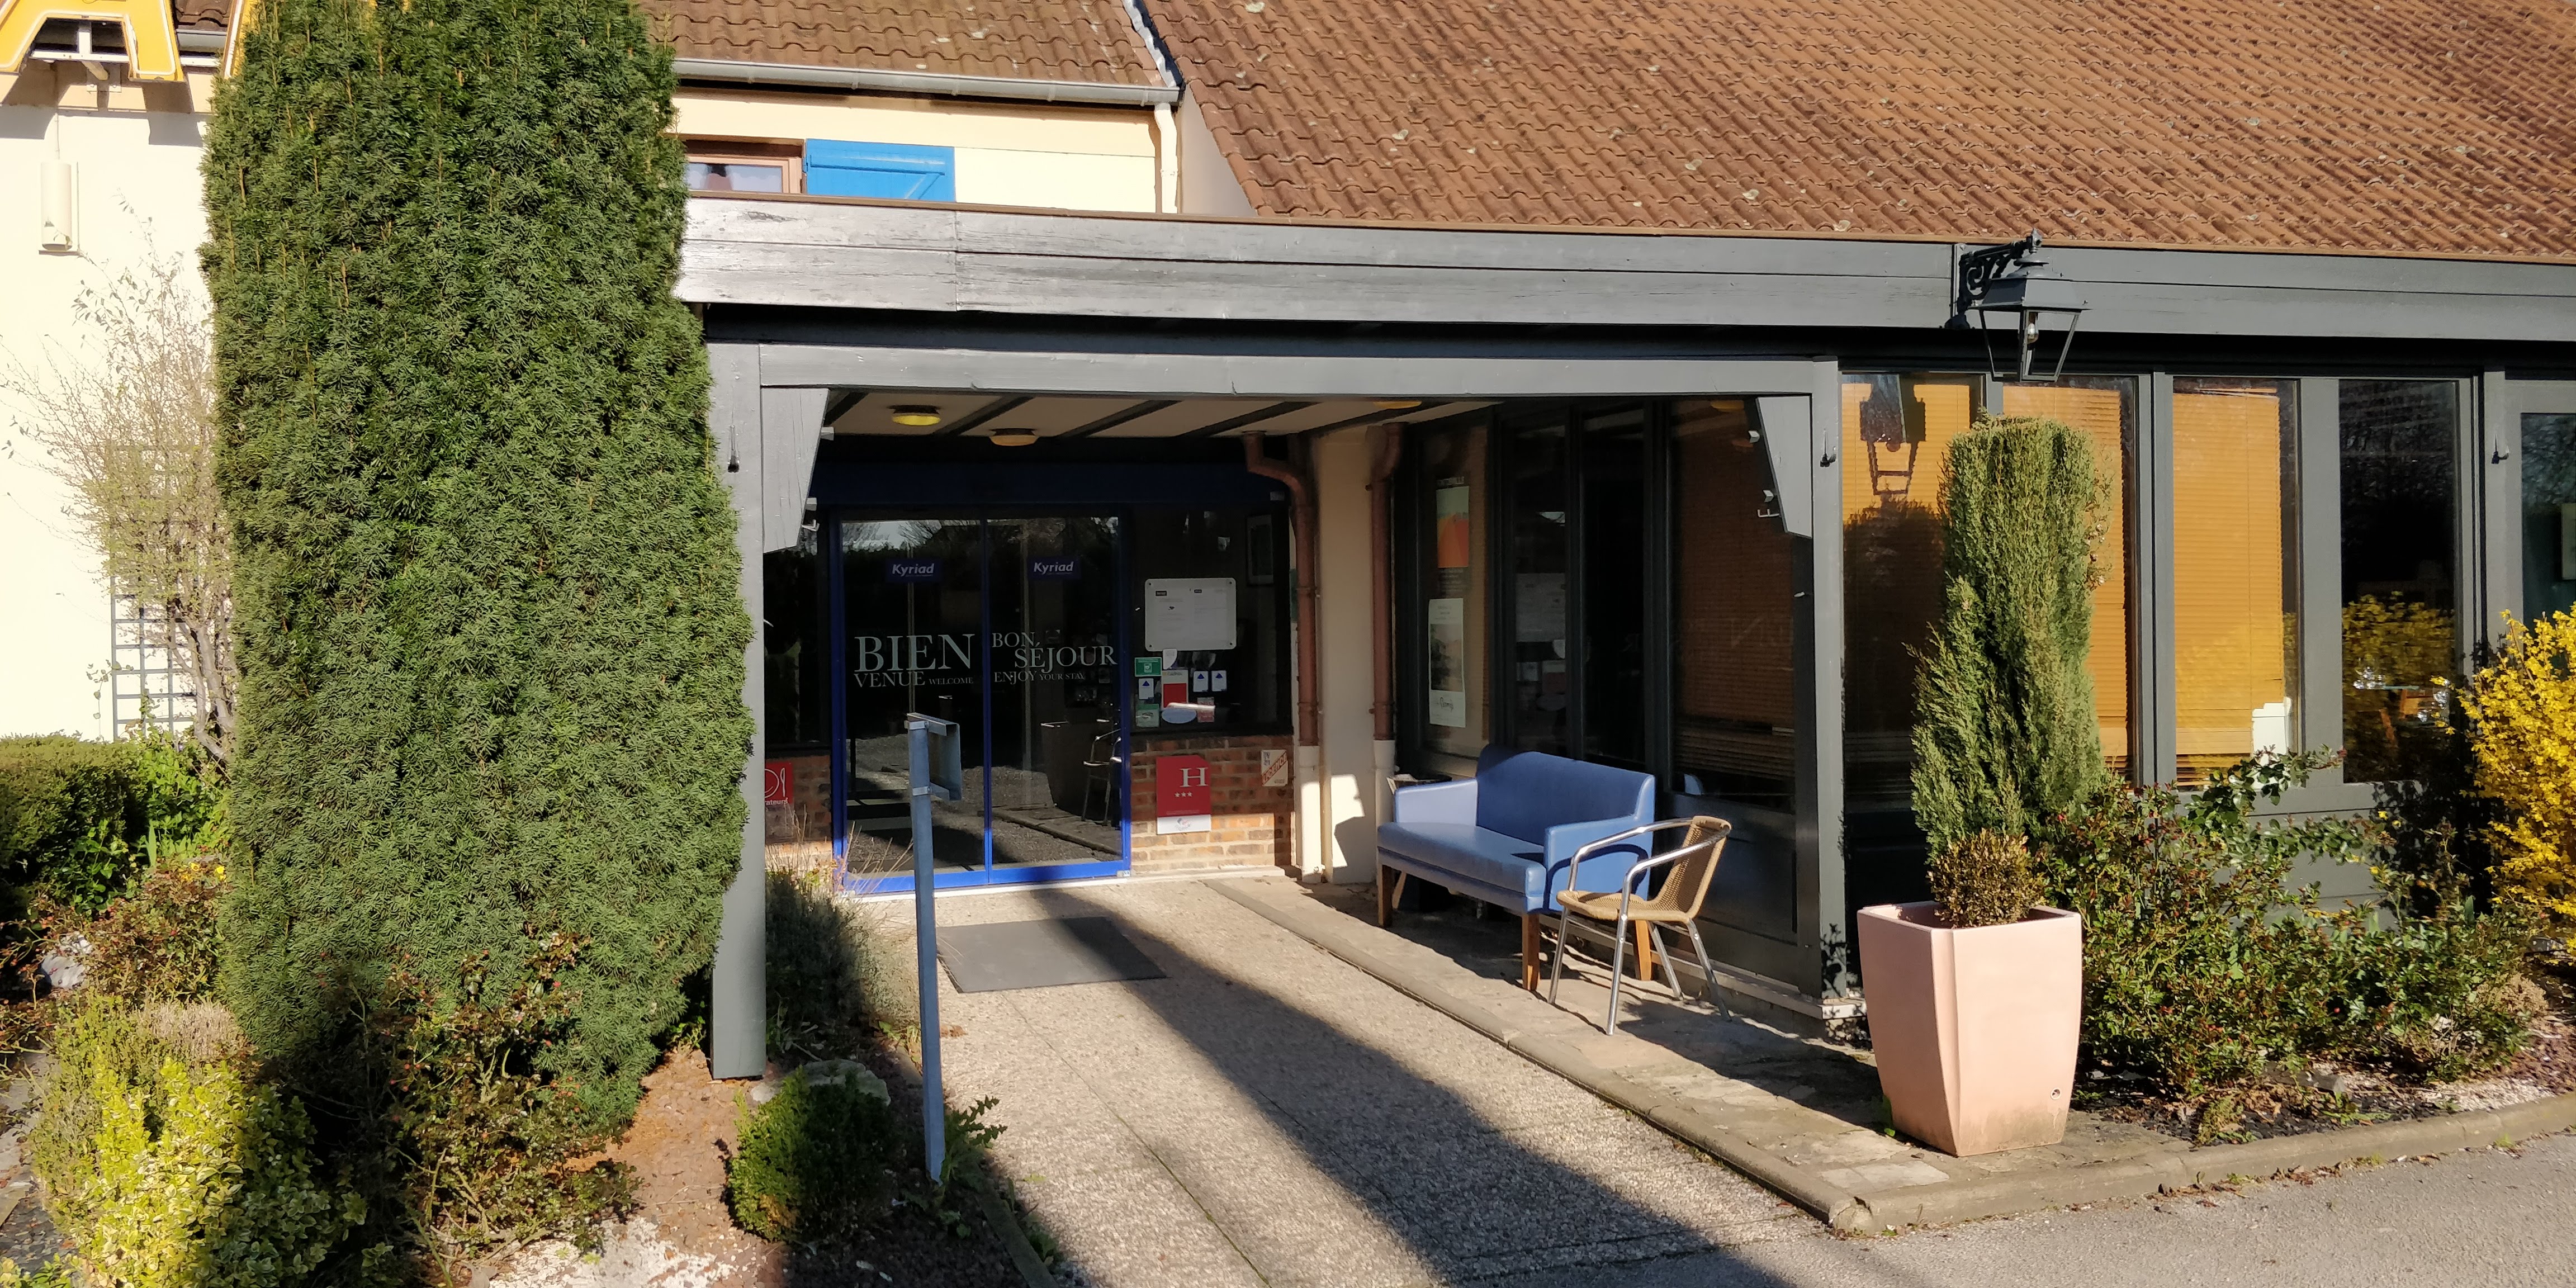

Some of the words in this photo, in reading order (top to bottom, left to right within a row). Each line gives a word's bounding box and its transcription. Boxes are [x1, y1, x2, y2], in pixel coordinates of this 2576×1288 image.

[892, 563, 935, 577] Kyriad
[1034, 561, 1074, 575] Kyriad
[992, 632, 1036, 648] BON
[854, 633, 976, 672] BIEN
[1015, 642, 1118, 674] SÉJOUR
[854, 671, 926, 688] VENUE
[929, 676, 974, 685] WELCOME
[995, 670, 1037, 685] ENJOY
[1039, 673, 1064, 681] YOUR
[1065, 671, 1087, 680] STAY
[1180, 767, 1209, 788] H
